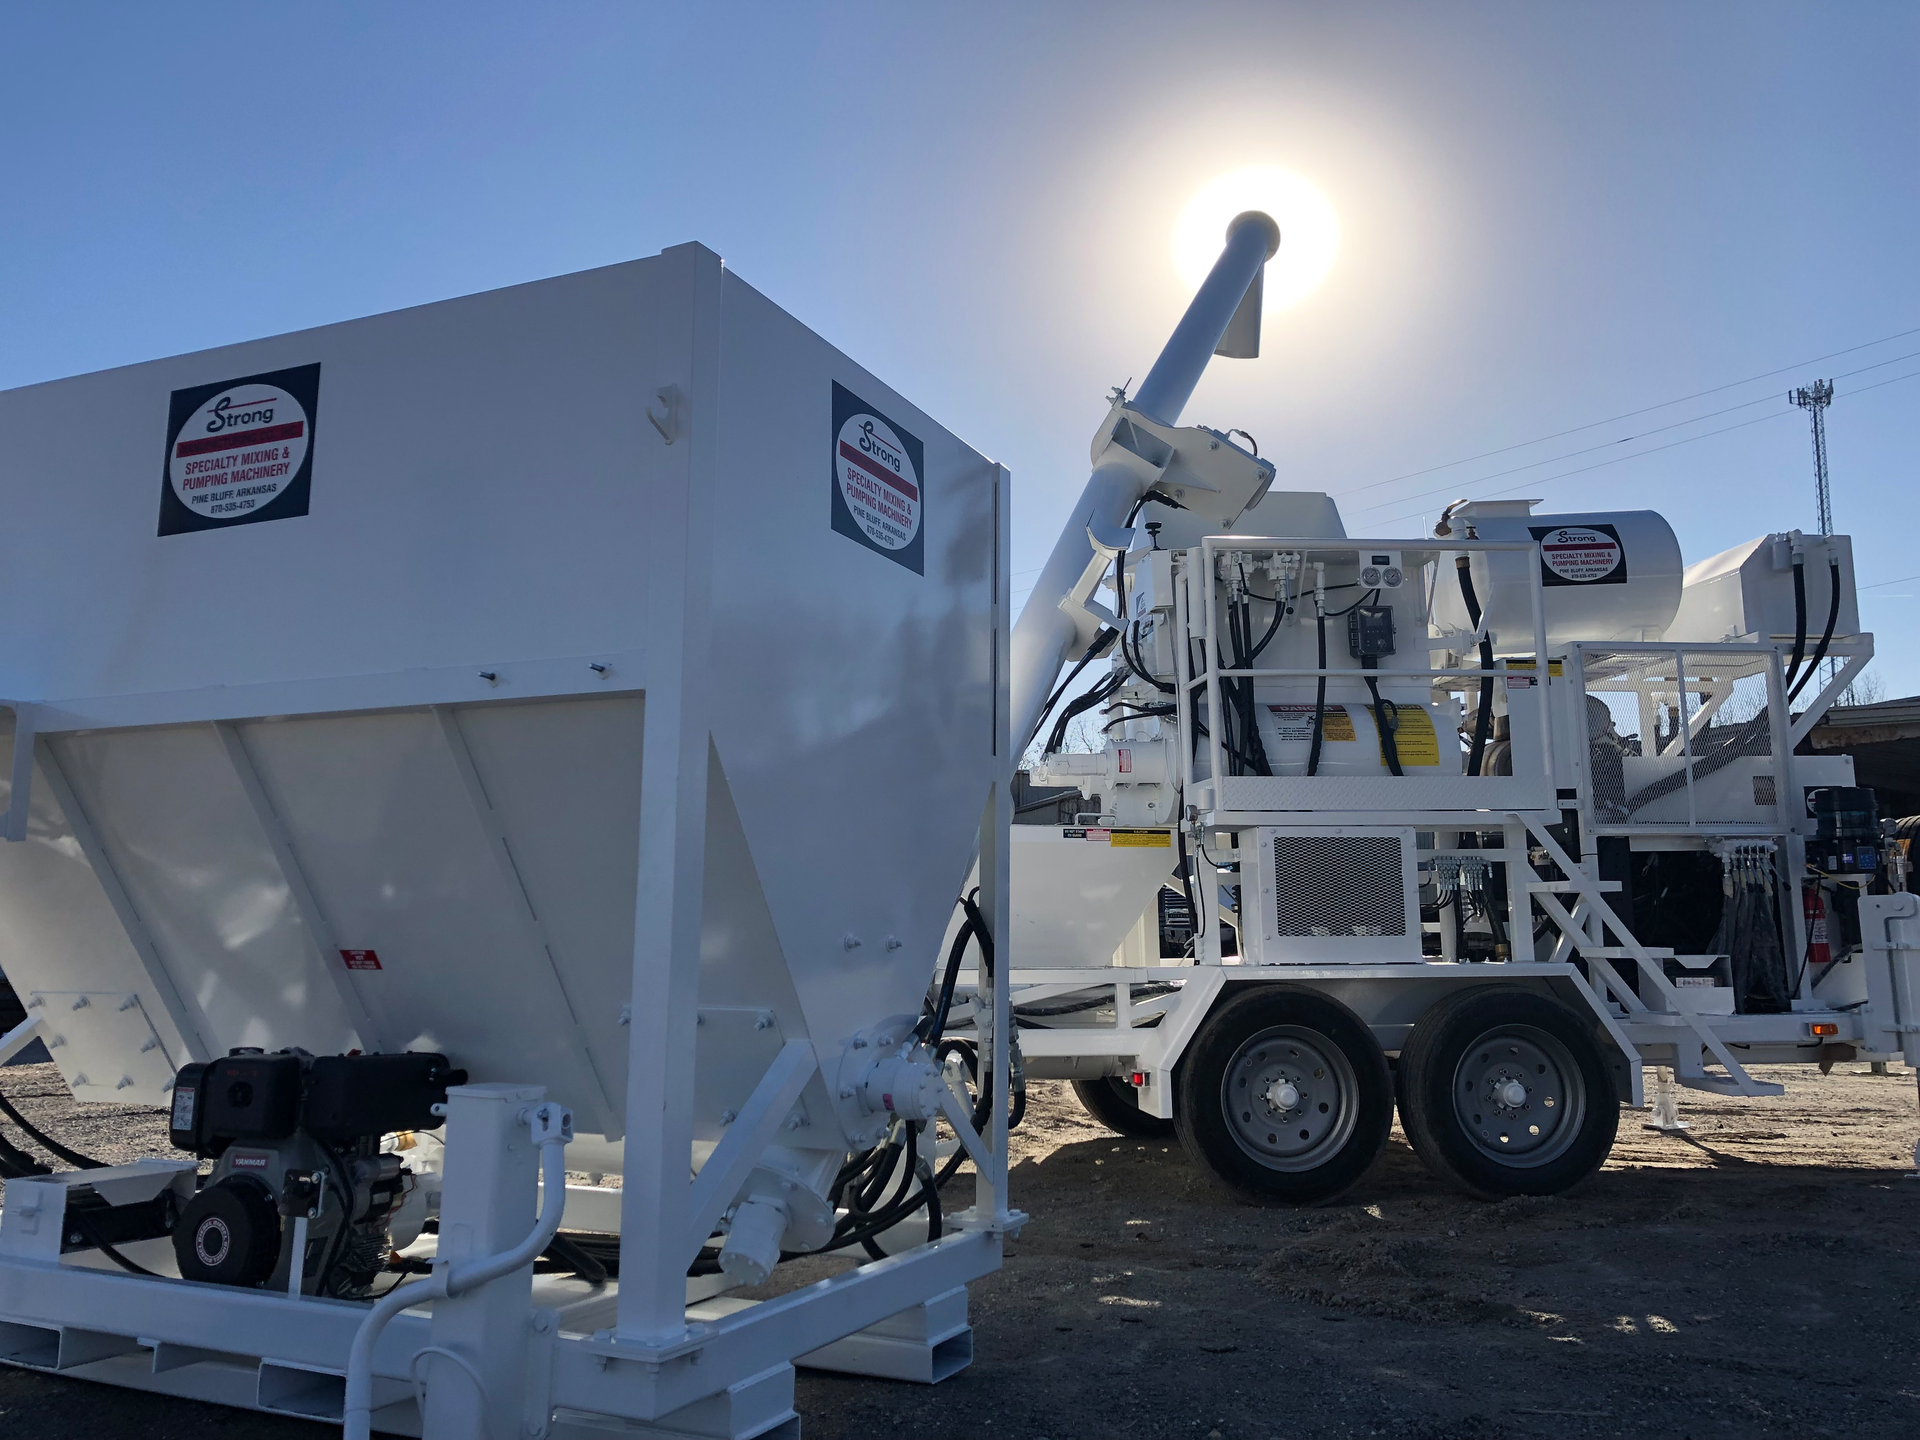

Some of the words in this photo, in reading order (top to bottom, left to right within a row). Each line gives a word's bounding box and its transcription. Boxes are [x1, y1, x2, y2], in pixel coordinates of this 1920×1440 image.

[206, 397, 274, 432] Strong
[185, 454, 238, 475] SPECIALTY
[241, 447, 279, 466] MIXING
[282, 446, 290, 459] &
[859, 421, 901, 472] Strong
[183, 471, 228, 491] PUMPING
[231, 462, 291, 483] MACHINERY
[192, 493, 209, 504] PINE
[210, 489, 234, 501] BLUFF,
[236, 483, 277, 497] ARKANSAS
[846, 482, 877, 510] PUMPING
[877, 500, 913, 530] MACHINERY
[847, 467, 882, 497] SPECIALTY
[883, 488, 906, 511] MIXING
[906, 503, 912, 516] &
[210, 499, 256, 514] 870-535-4753
[853, 505, 865, 519] PINE
[866, 511, 881, 529] BLUFF,
[882, 521, 907, 541] ARKANSAS
[1557, 530, 1597, 543] Strong
[1551, 552, 1583, 560] SPECIALTY
[1580, 558, 1614, 566] MACHINERY
[235, 1158, 266, 1166] YANMAR
